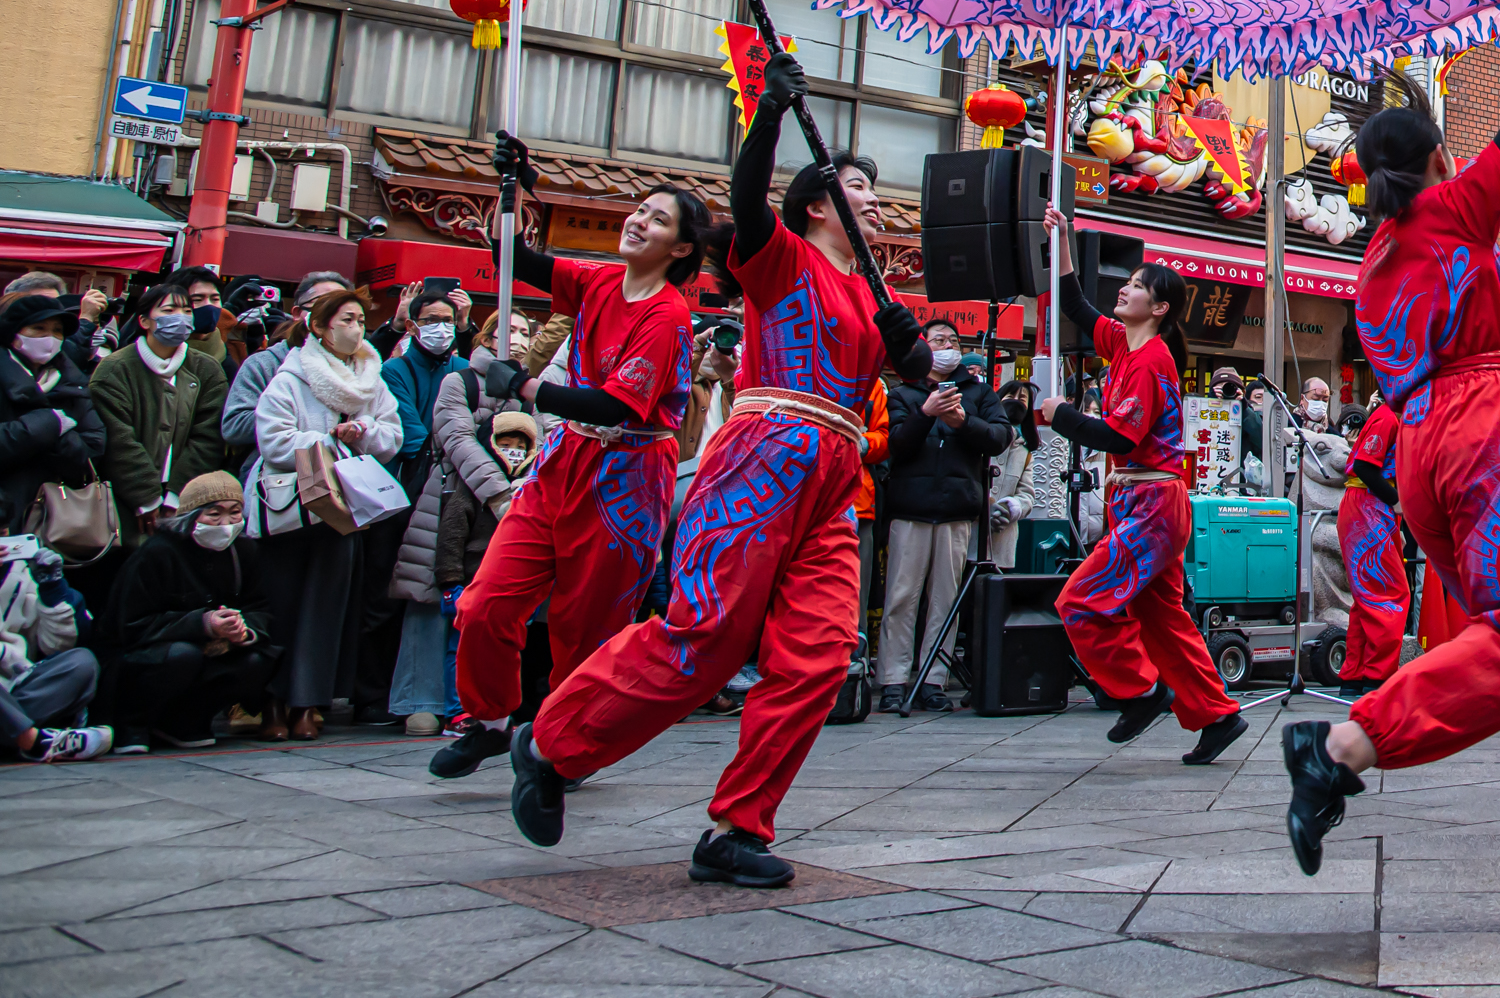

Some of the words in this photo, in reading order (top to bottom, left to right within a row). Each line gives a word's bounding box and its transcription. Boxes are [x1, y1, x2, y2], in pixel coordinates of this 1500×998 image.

[744, 45, 767, 103] 春節祭
[1298, 71, 1369, 102] DRAGON
[1078, 166, 1100, 177] イレ
[1205, 265, 1248, 279] MOON
[1256, 272, 1315, 289] DGON
[1200, 409, 1230, 421] ご注意
